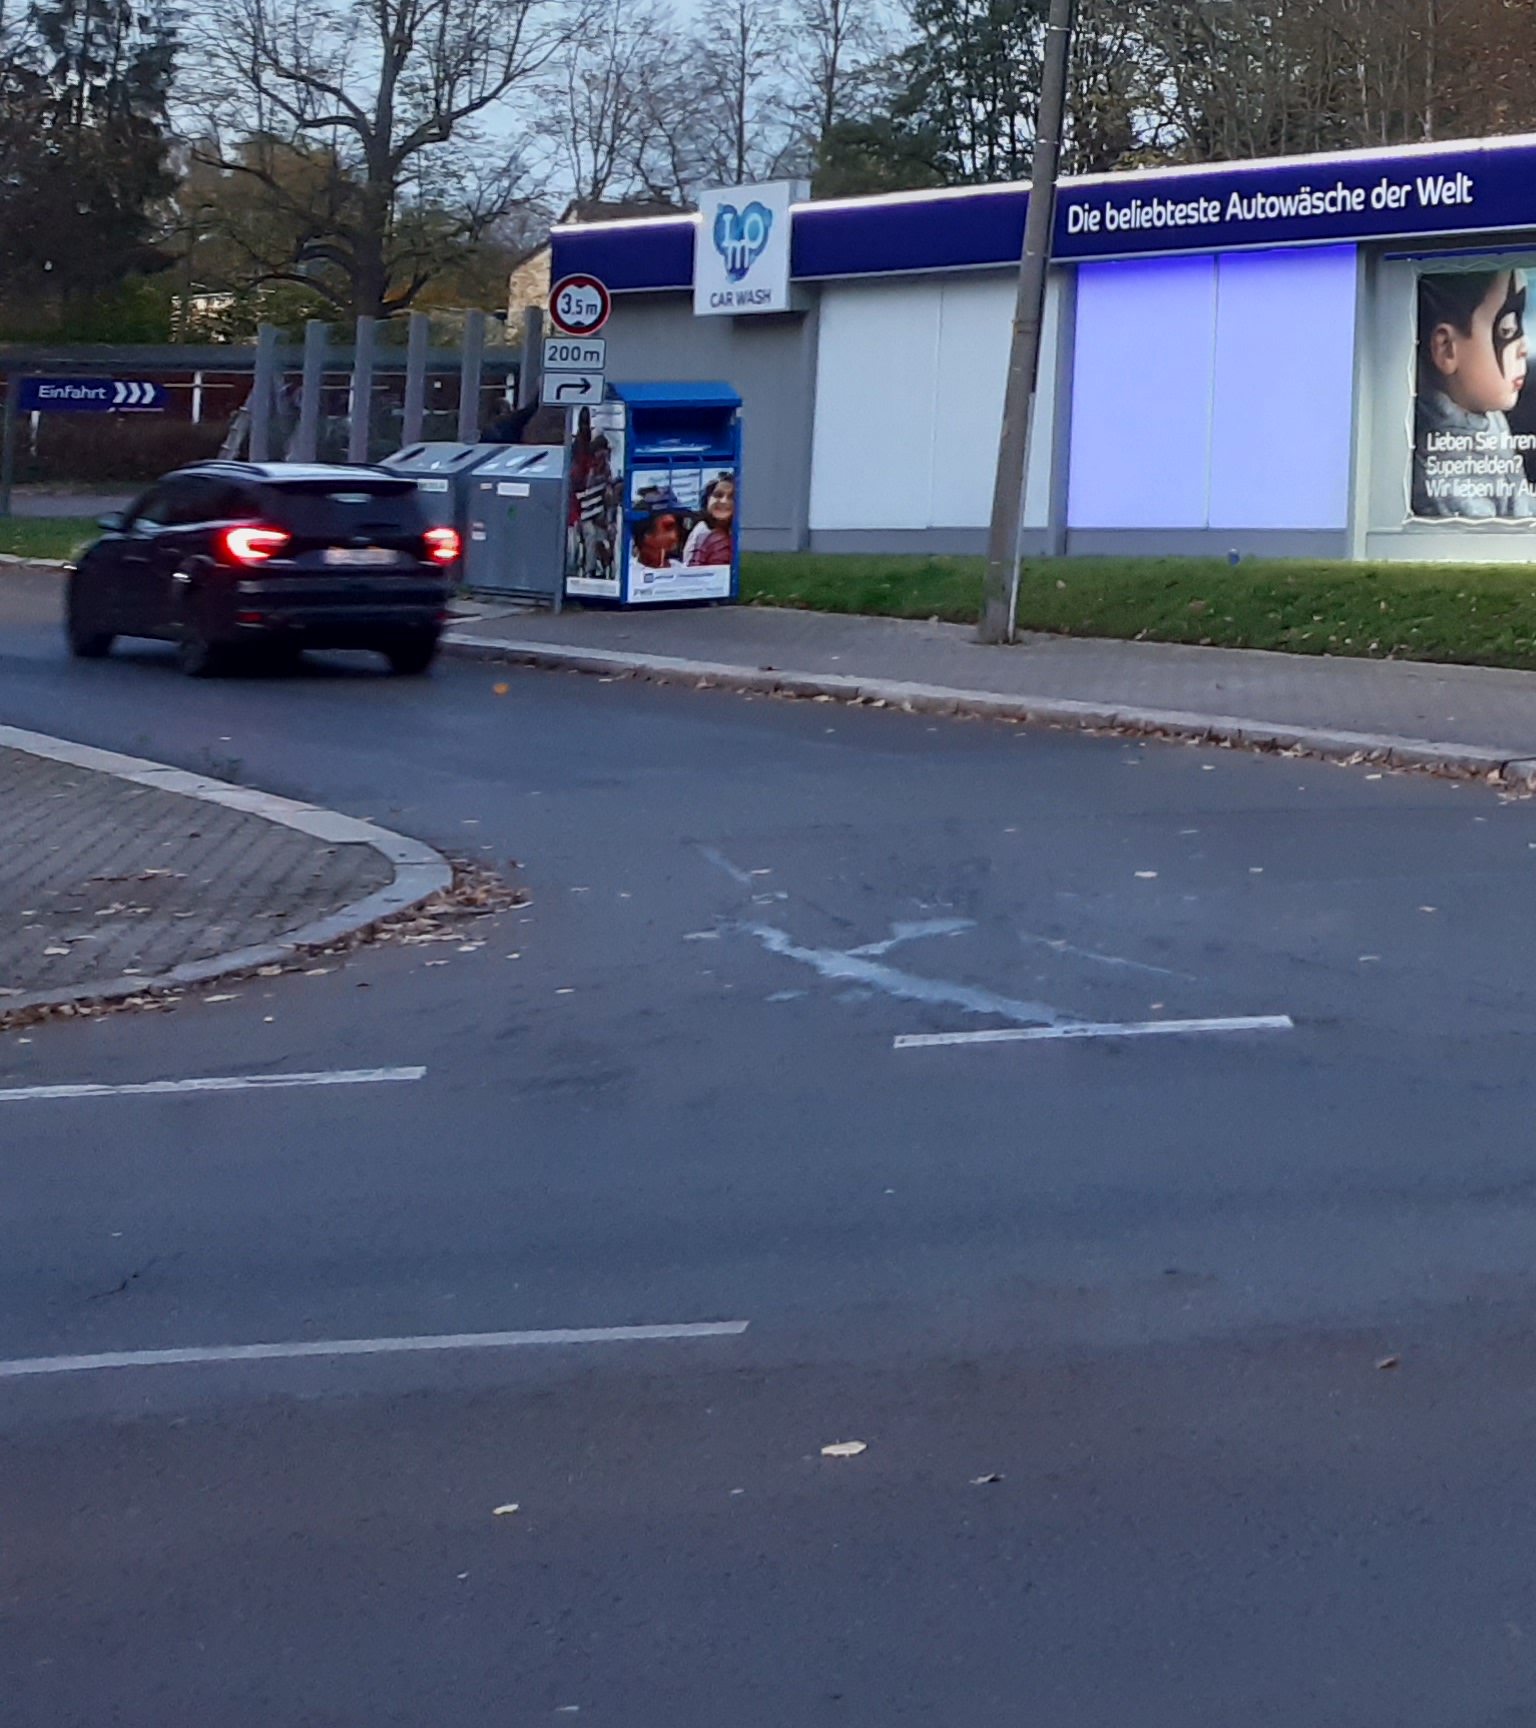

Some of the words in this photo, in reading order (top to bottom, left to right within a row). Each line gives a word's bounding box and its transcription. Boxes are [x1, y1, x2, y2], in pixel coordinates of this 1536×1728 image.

[1066, 203, 1101, 235] Die
[1104, 196, 1221, 232] beliebteste
[1225, 181, 1366, 222] Autowäsche
[1370, 177, 1412, 209] der
[1415, 172, 1474, 207] Welt
[709, 291, 733, 308] CAR
[735, 288, 772, 307] WASH
[37, 384, 107, 400] Einfahrt
[1426, 431, 1473, 451] Lieben
[1475, 432, 1497, 451] Sie
[1425, 454, 1524, 477] Superhelden?
[1425, 480, 1453, 498] Wir
[1453, 479, 1495, 497] lieben
[1496, 478, 1517, 497] Ihr
